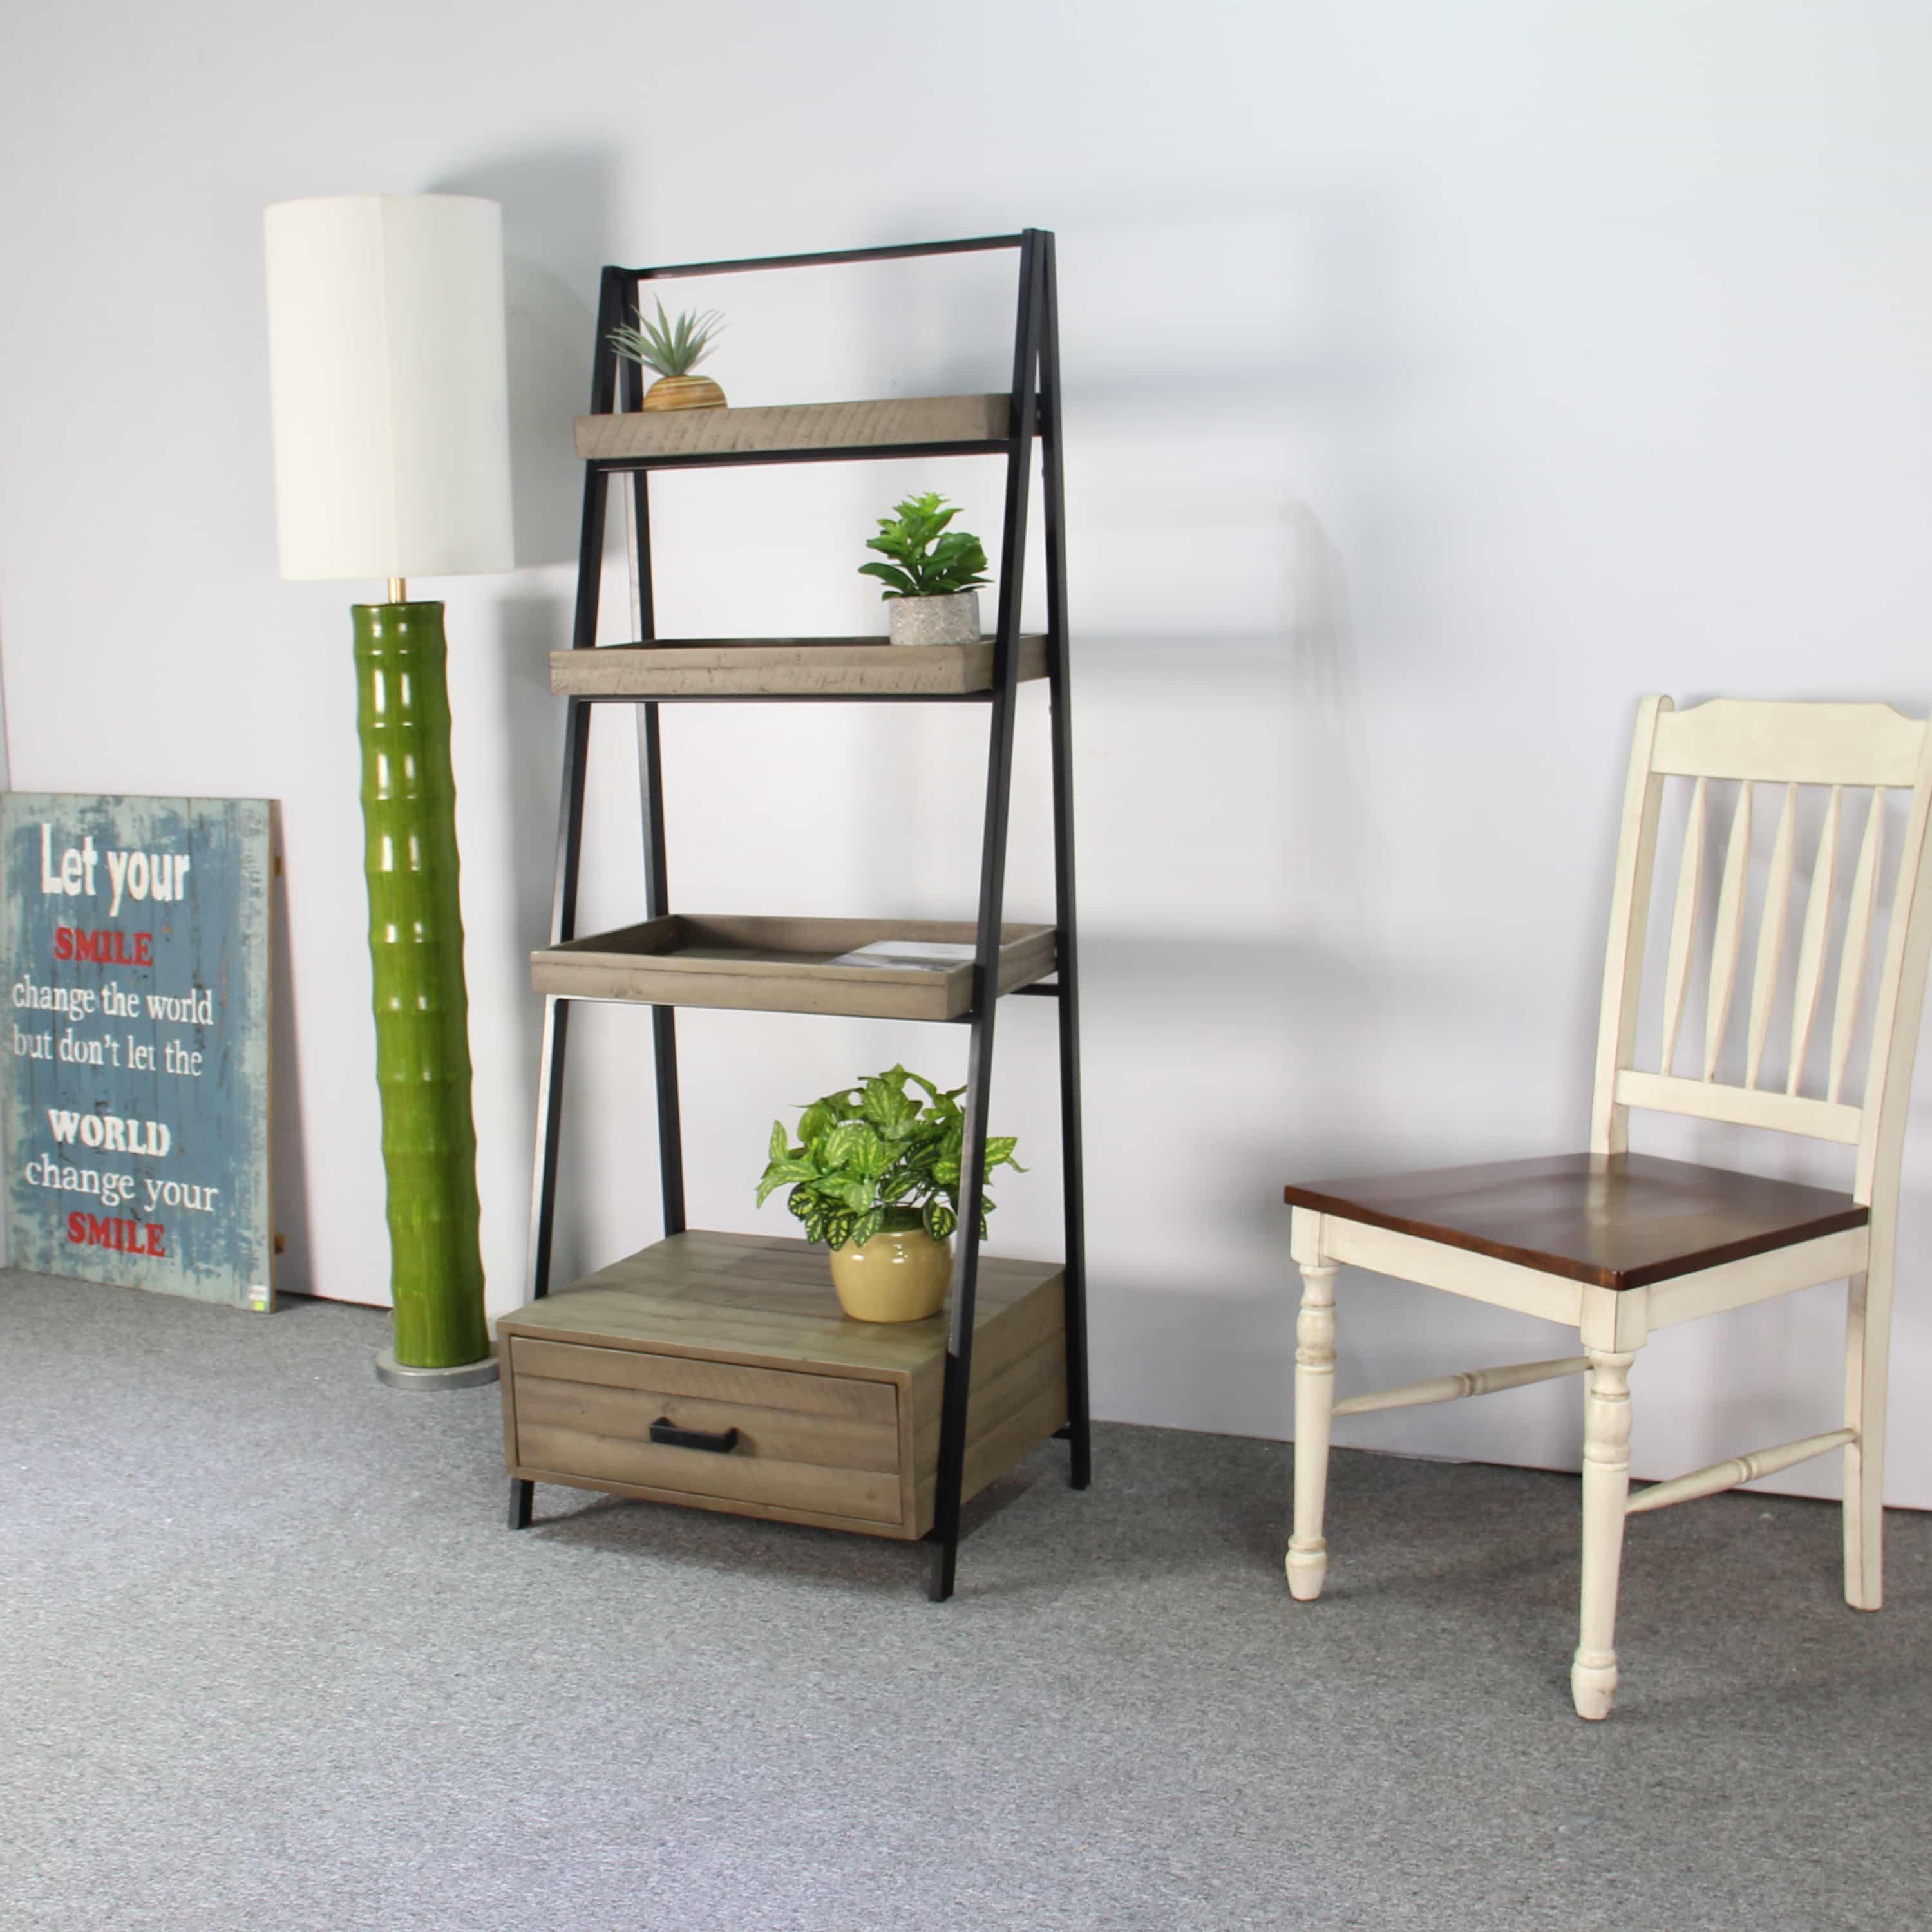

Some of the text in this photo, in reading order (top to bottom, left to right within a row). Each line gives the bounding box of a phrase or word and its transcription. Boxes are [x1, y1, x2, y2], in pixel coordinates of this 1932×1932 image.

[41, 822, 191, 917] Let your
[53, 927, 154, 967] SMILE
[12, 974, 214, 1025] change the world
[12, 1024, 204, 1076] but don't let the
[47, 1108, 171, 1157] WORLD
[24, 1153, 219, 1212] change your
[67, 1211, 166, 1258] SMILE
